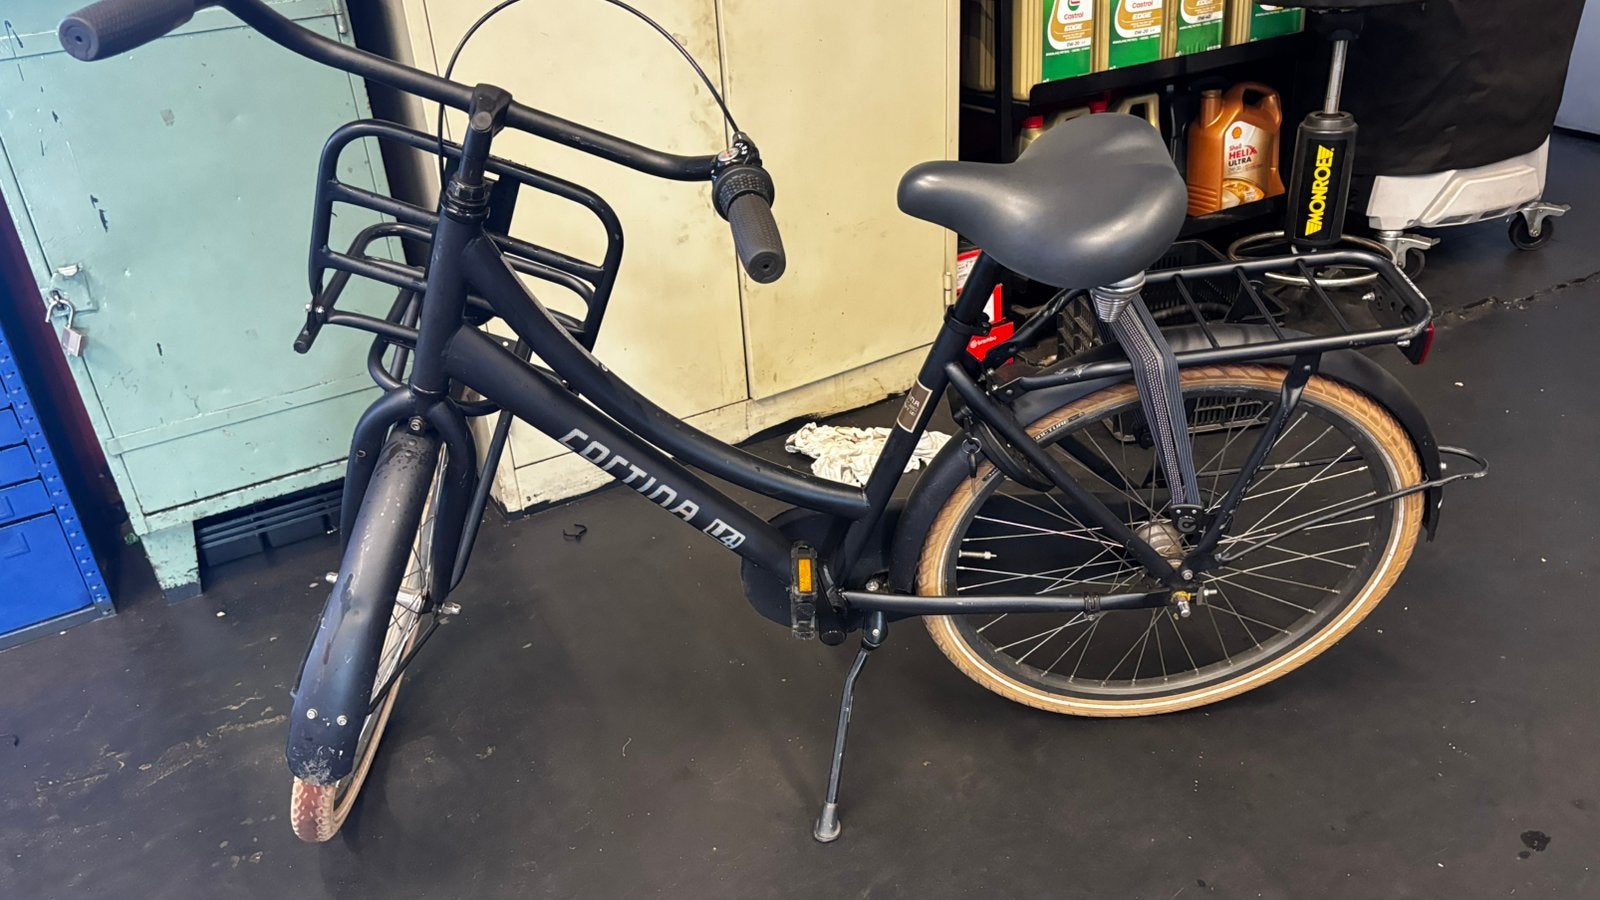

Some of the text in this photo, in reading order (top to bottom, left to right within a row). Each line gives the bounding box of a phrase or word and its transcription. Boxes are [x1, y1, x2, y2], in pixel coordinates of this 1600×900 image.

[1132, 1, 1153, 9] Castrol
[1064, 11, 1084, 20] Castrol
[1228, 145, 1258, 160] HELIX
[1229, 143, 1242, 152] Shell
[1228, 156, 1252, 167] ULTRA
[1305, 144, 1333, 236] MONROE
